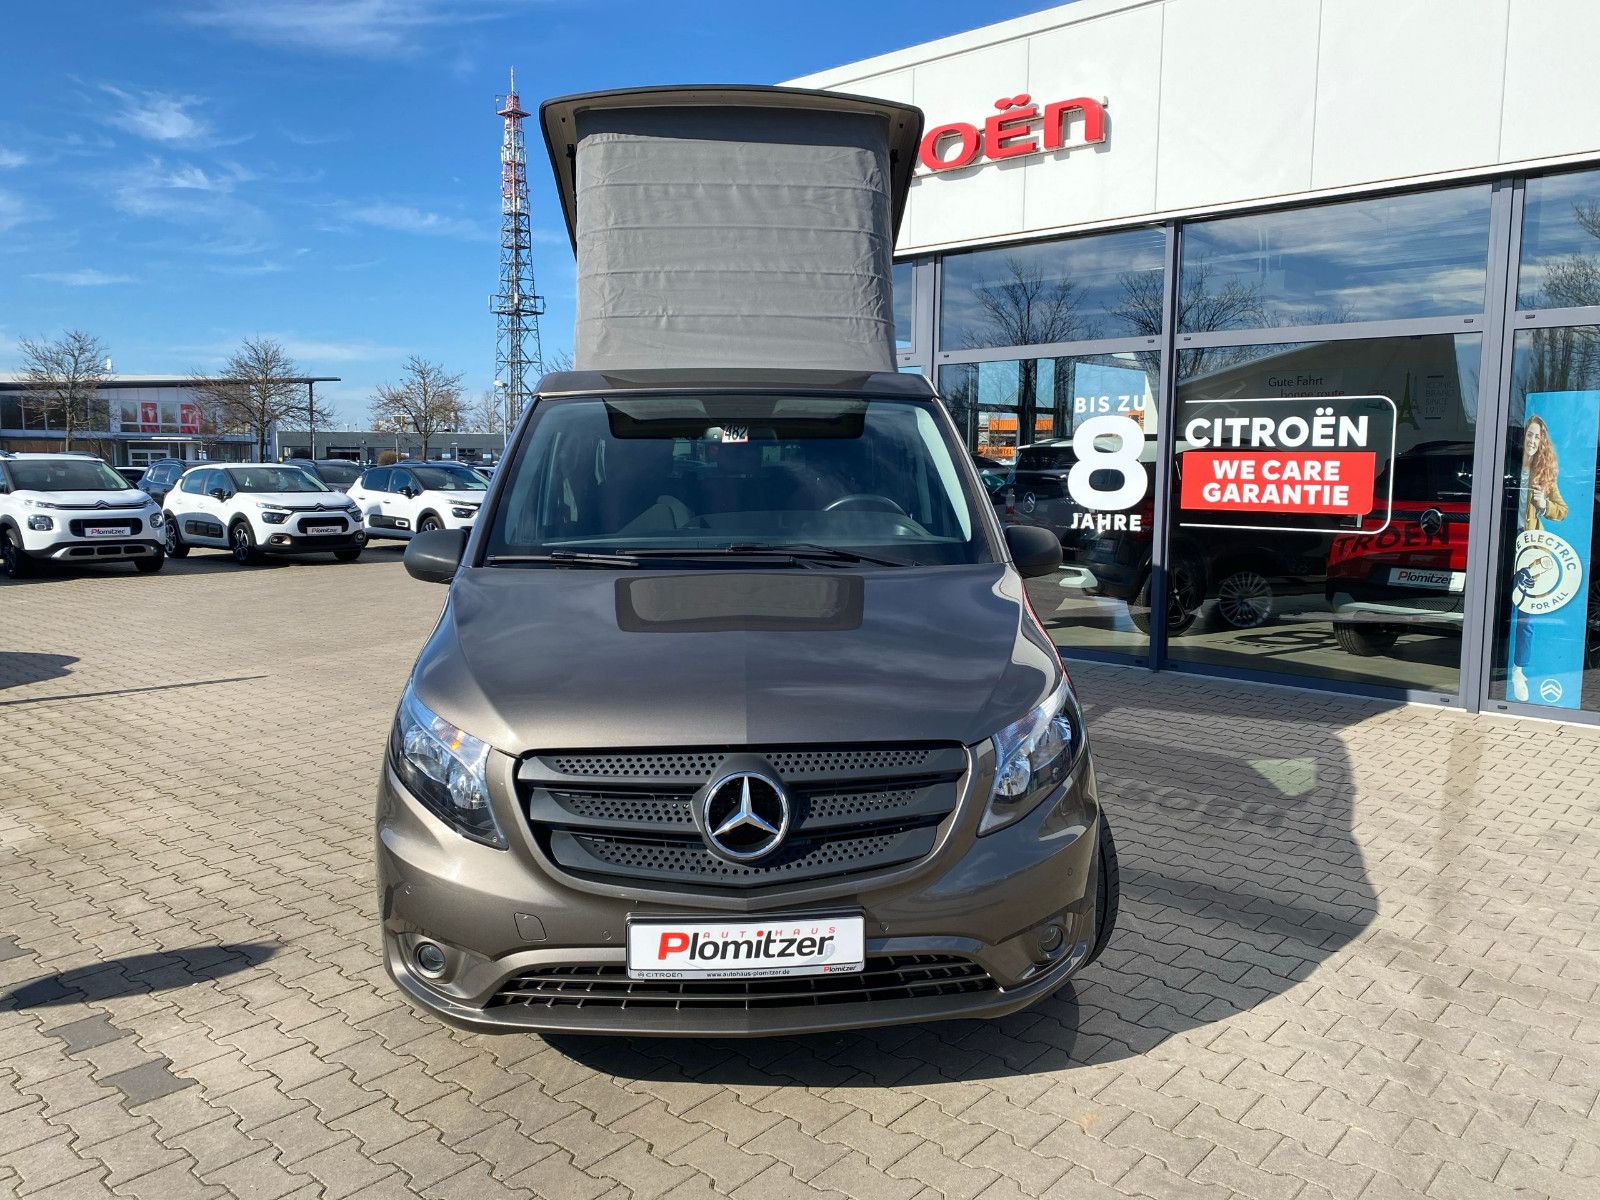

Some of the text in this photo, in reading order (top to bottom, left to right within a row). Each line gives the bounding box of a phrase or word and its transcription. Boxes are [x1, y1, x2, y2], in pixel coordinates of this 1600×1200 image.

[914, 93, 1105, 172] OËN
[1268, 374, 1324, 387] Gute Fahrt
[1075, 395, 1146, 413] BIS ZU
[724, 424, 748, 441] 482
[1184, 407, 1369, 448] CITROËN
[1067, 415, 1148, 511] 8
[1212, 460, 1341, 481] WE CARE
[1202, 482, 1349, 506] GARANTIE
[1070, 512, 1142, 532] JAHRE
[1530, 592, 1569, 610] FOR ALL
[657, 930, 835, 960] Plomitzer
[706, 969, 790, 978] www.autohaus-plomitzer.de
[823, 964, 856, 972] Plomitzer
